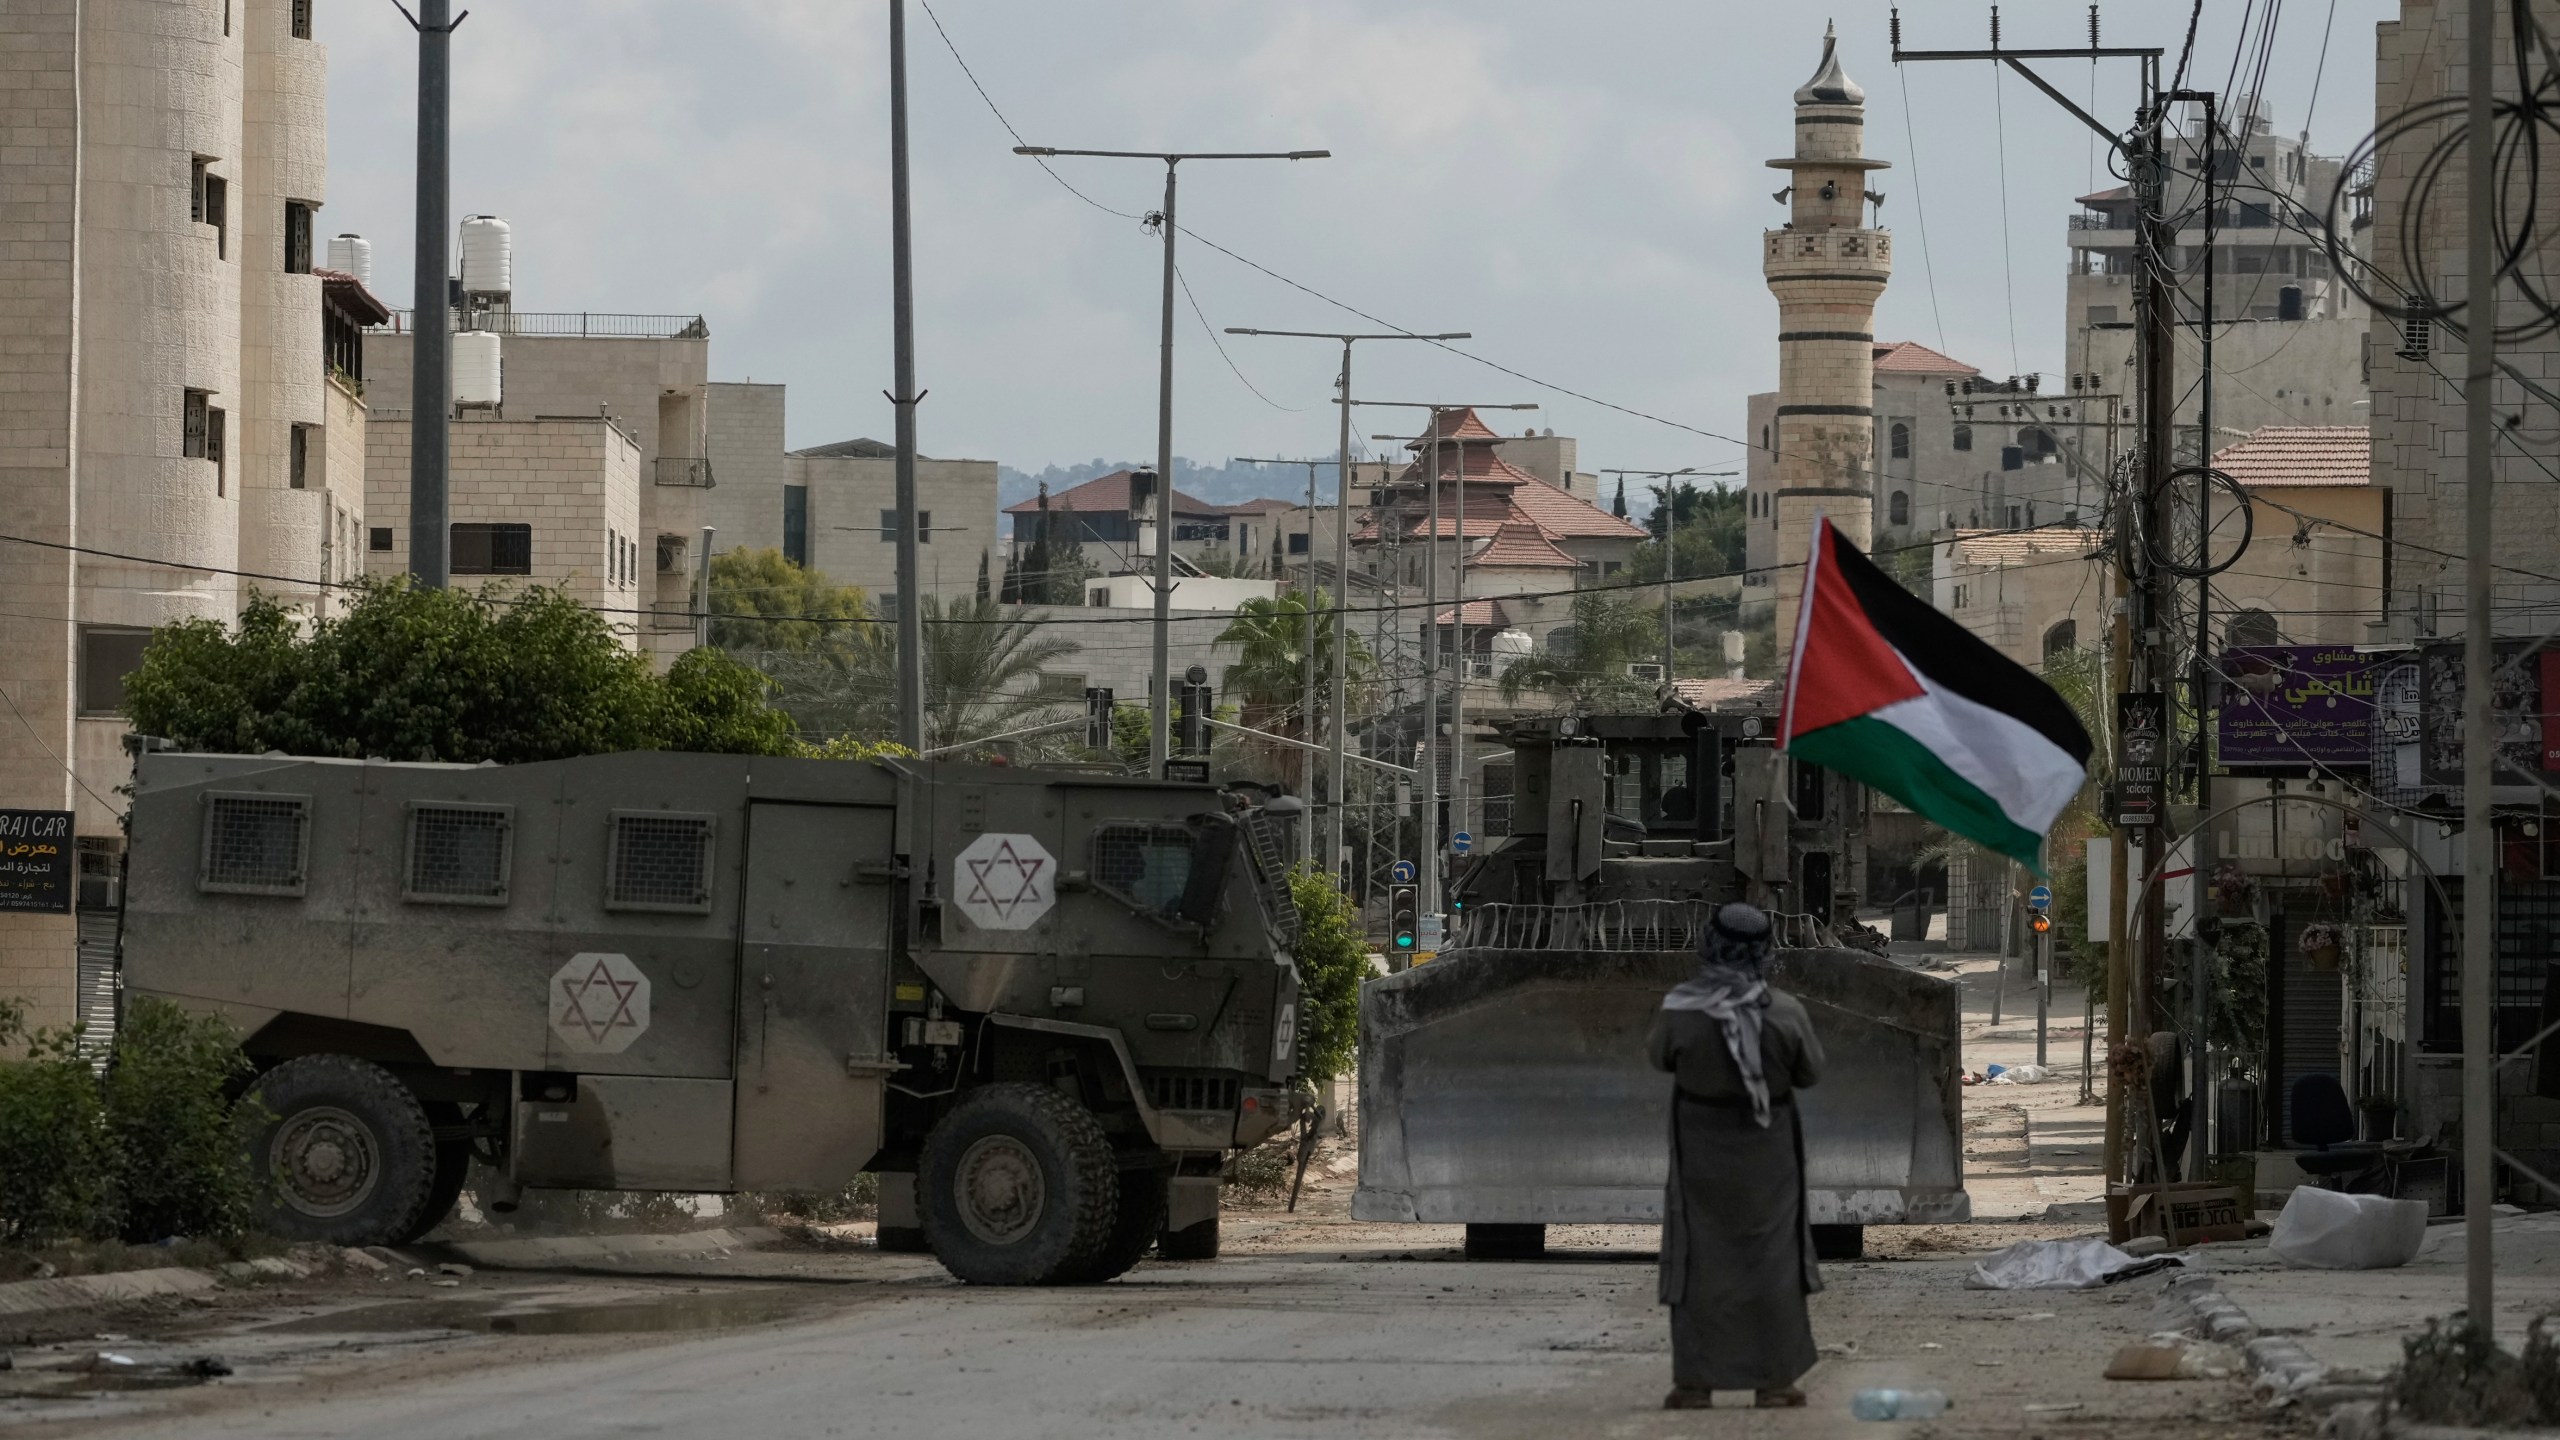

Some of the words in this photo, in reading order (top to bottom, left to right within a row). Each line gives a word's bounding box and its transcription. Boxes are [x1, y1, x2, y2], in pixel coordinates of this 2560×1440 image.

[2312, 649, 2356, 666] مشاوي
[2117, 767, 2162, 782] MOMEN
[2126, 782, 2153, 794] saloon
[32, 816, 67, 837] CAR
[7, 842, 57, 857] معرض
[17, 861, 51, 875] لتجارة
